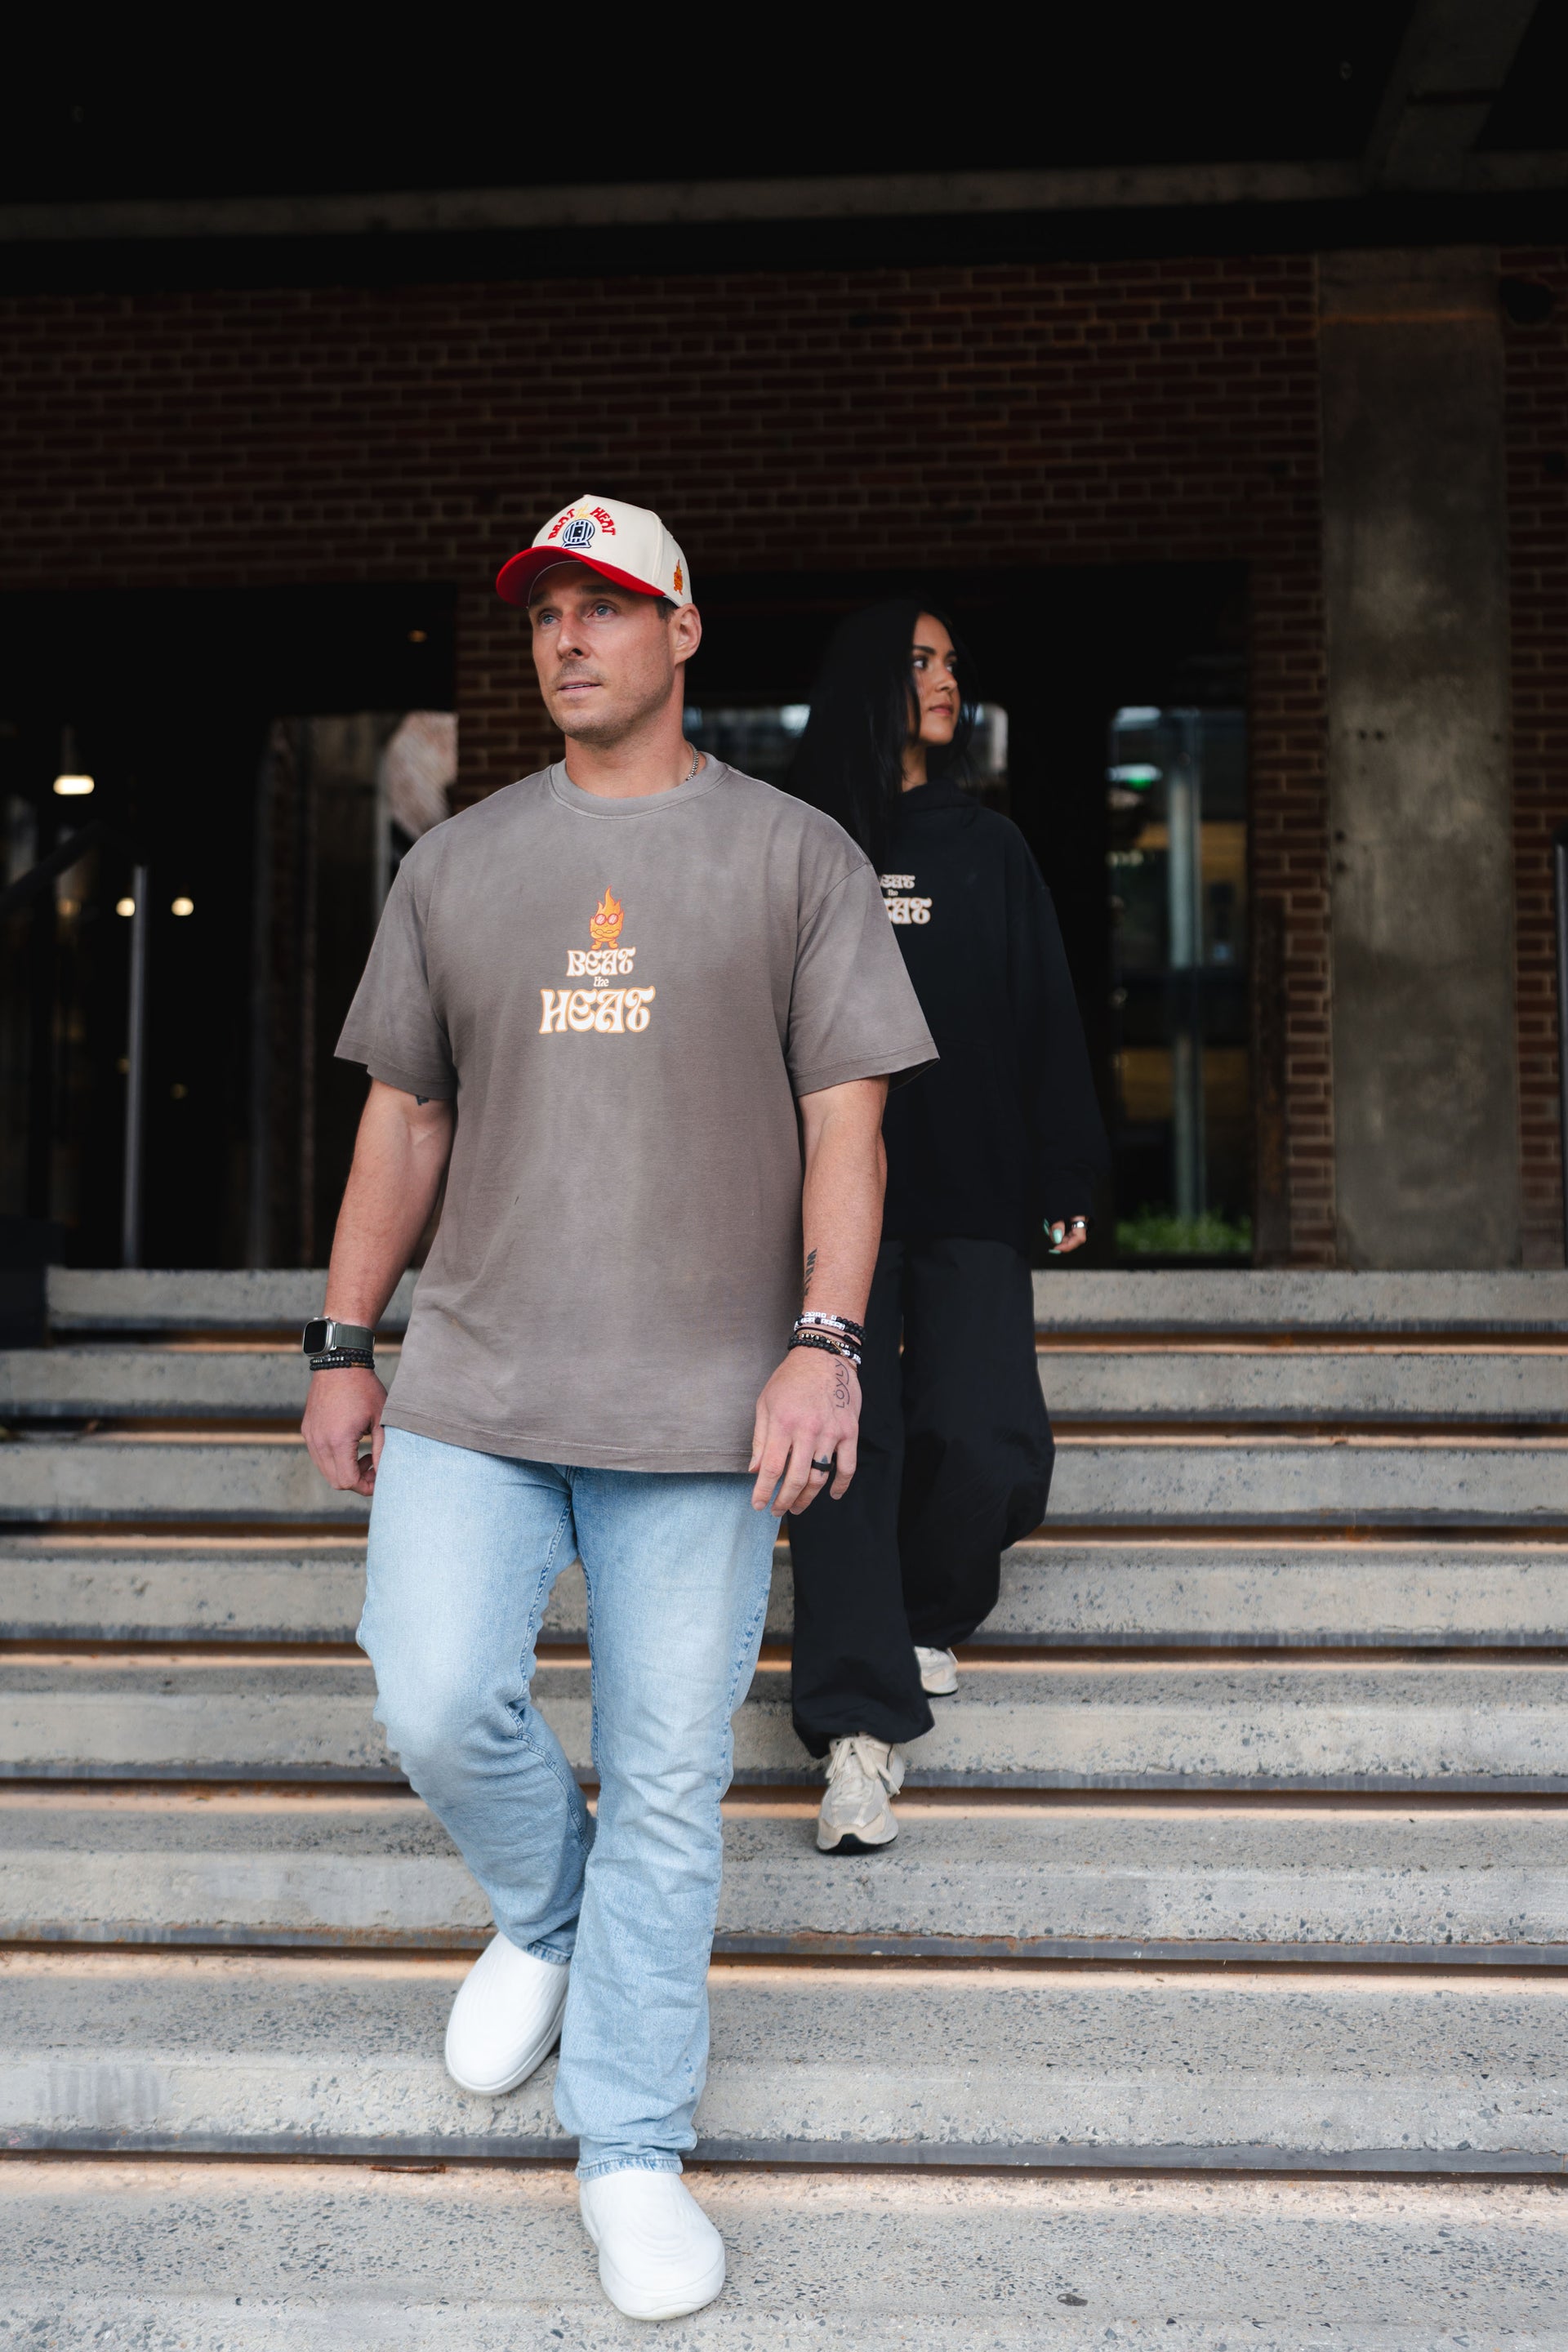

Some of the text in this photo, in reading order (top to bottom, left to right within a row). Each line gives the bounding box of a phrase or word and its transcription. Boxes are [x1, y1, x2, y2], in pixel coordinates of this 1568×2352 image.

[590, 506, 617, 536] HEAT
[880, 874, 915, 889] EAT
[883, 897, 933, 924] AT
[566, 947, 636, 977] BEAT
[593, 976, 609, 987] the
[538, 985, 656, 1034] HEAT
